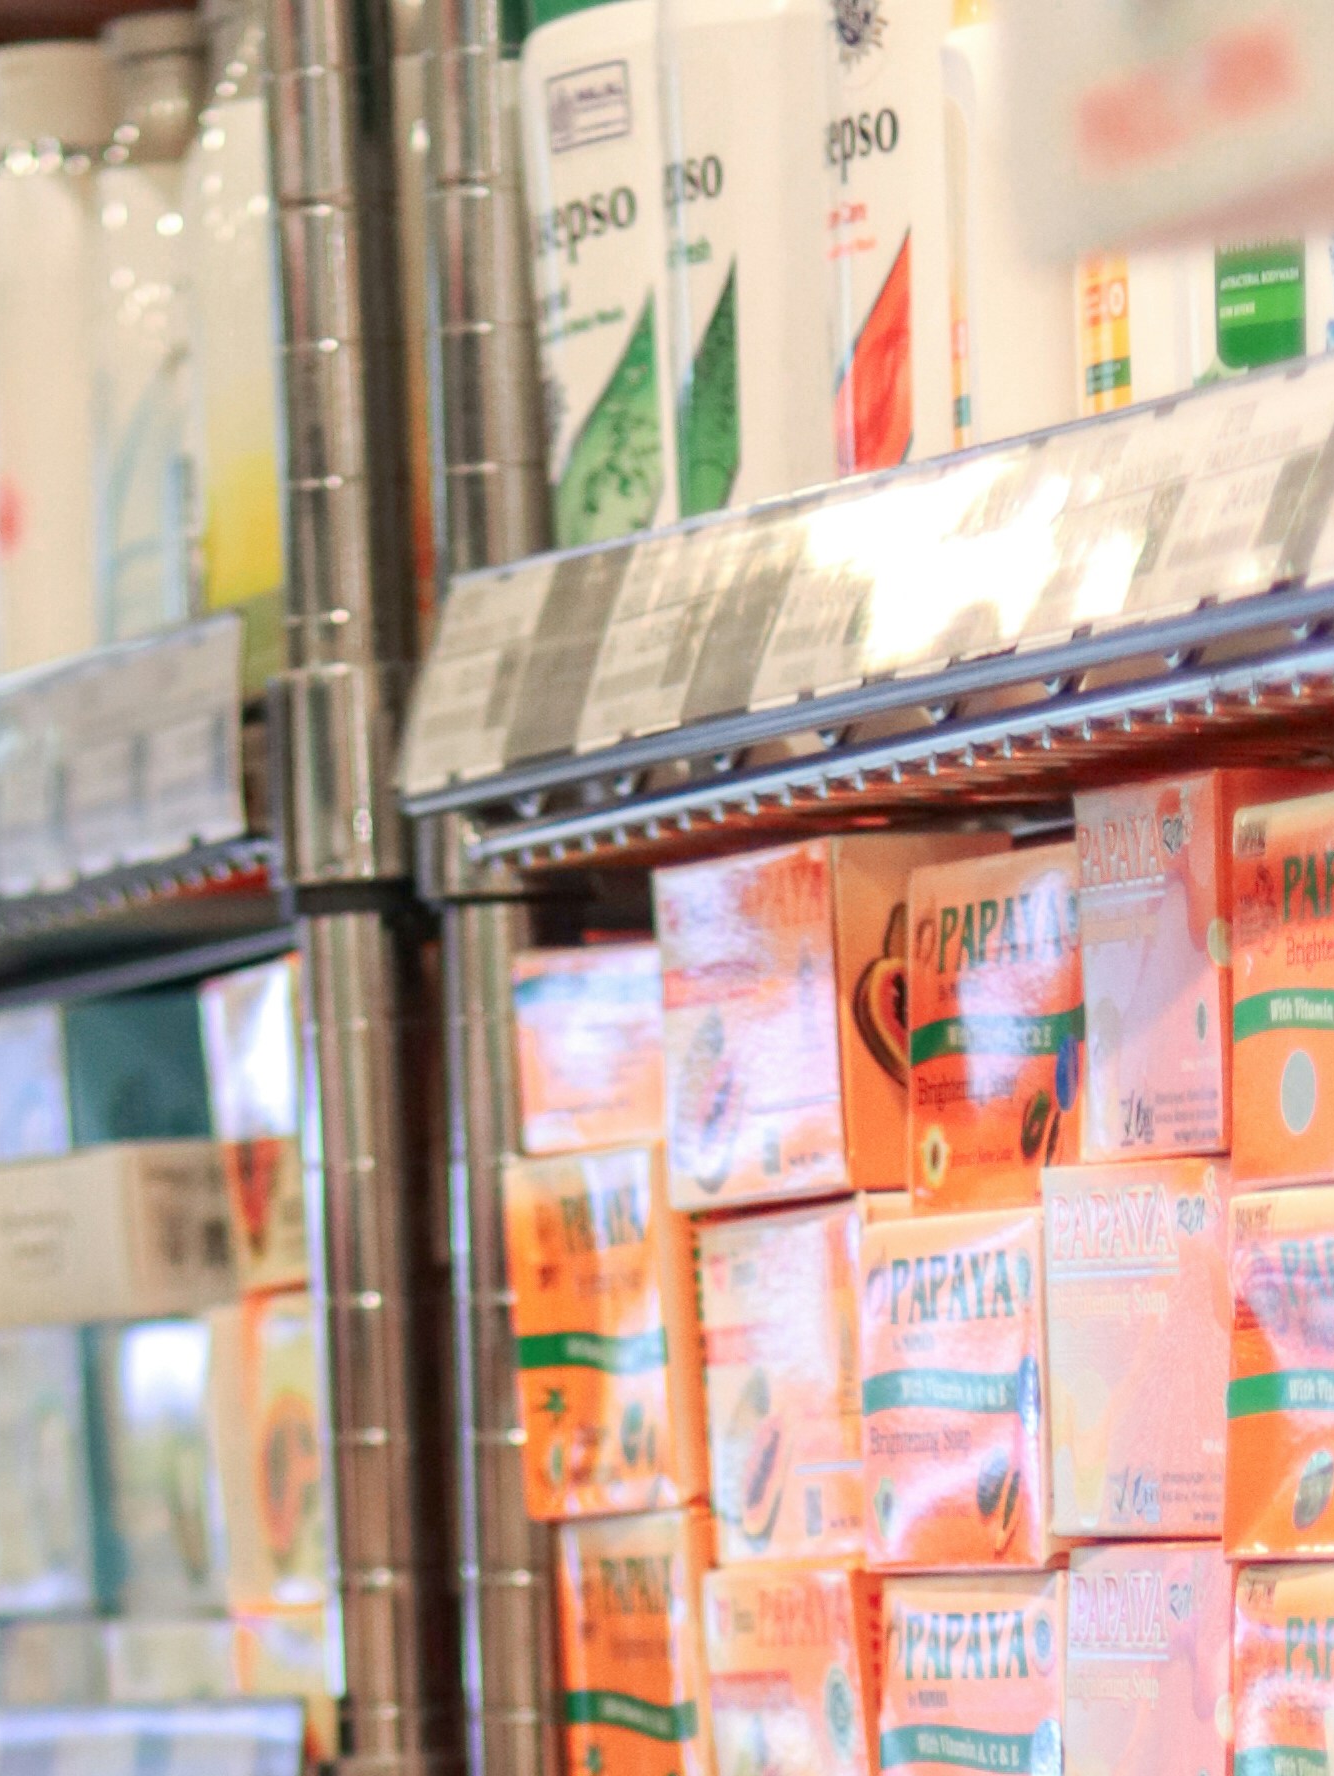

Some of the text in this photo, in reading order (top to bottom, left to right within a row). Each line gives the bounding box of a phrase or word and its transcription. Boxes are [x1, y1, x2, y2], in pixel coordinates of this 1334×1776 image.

[938, 889, 1064, 974] PAPAYA
[1270, 997, 1293, 1022] With
[1051, 1184, 1179, 1263] PAPAYA
[890, 1250, 1015, 1324] PAPAYA
[905, 1609, 1029, 1680] PAPAYA
